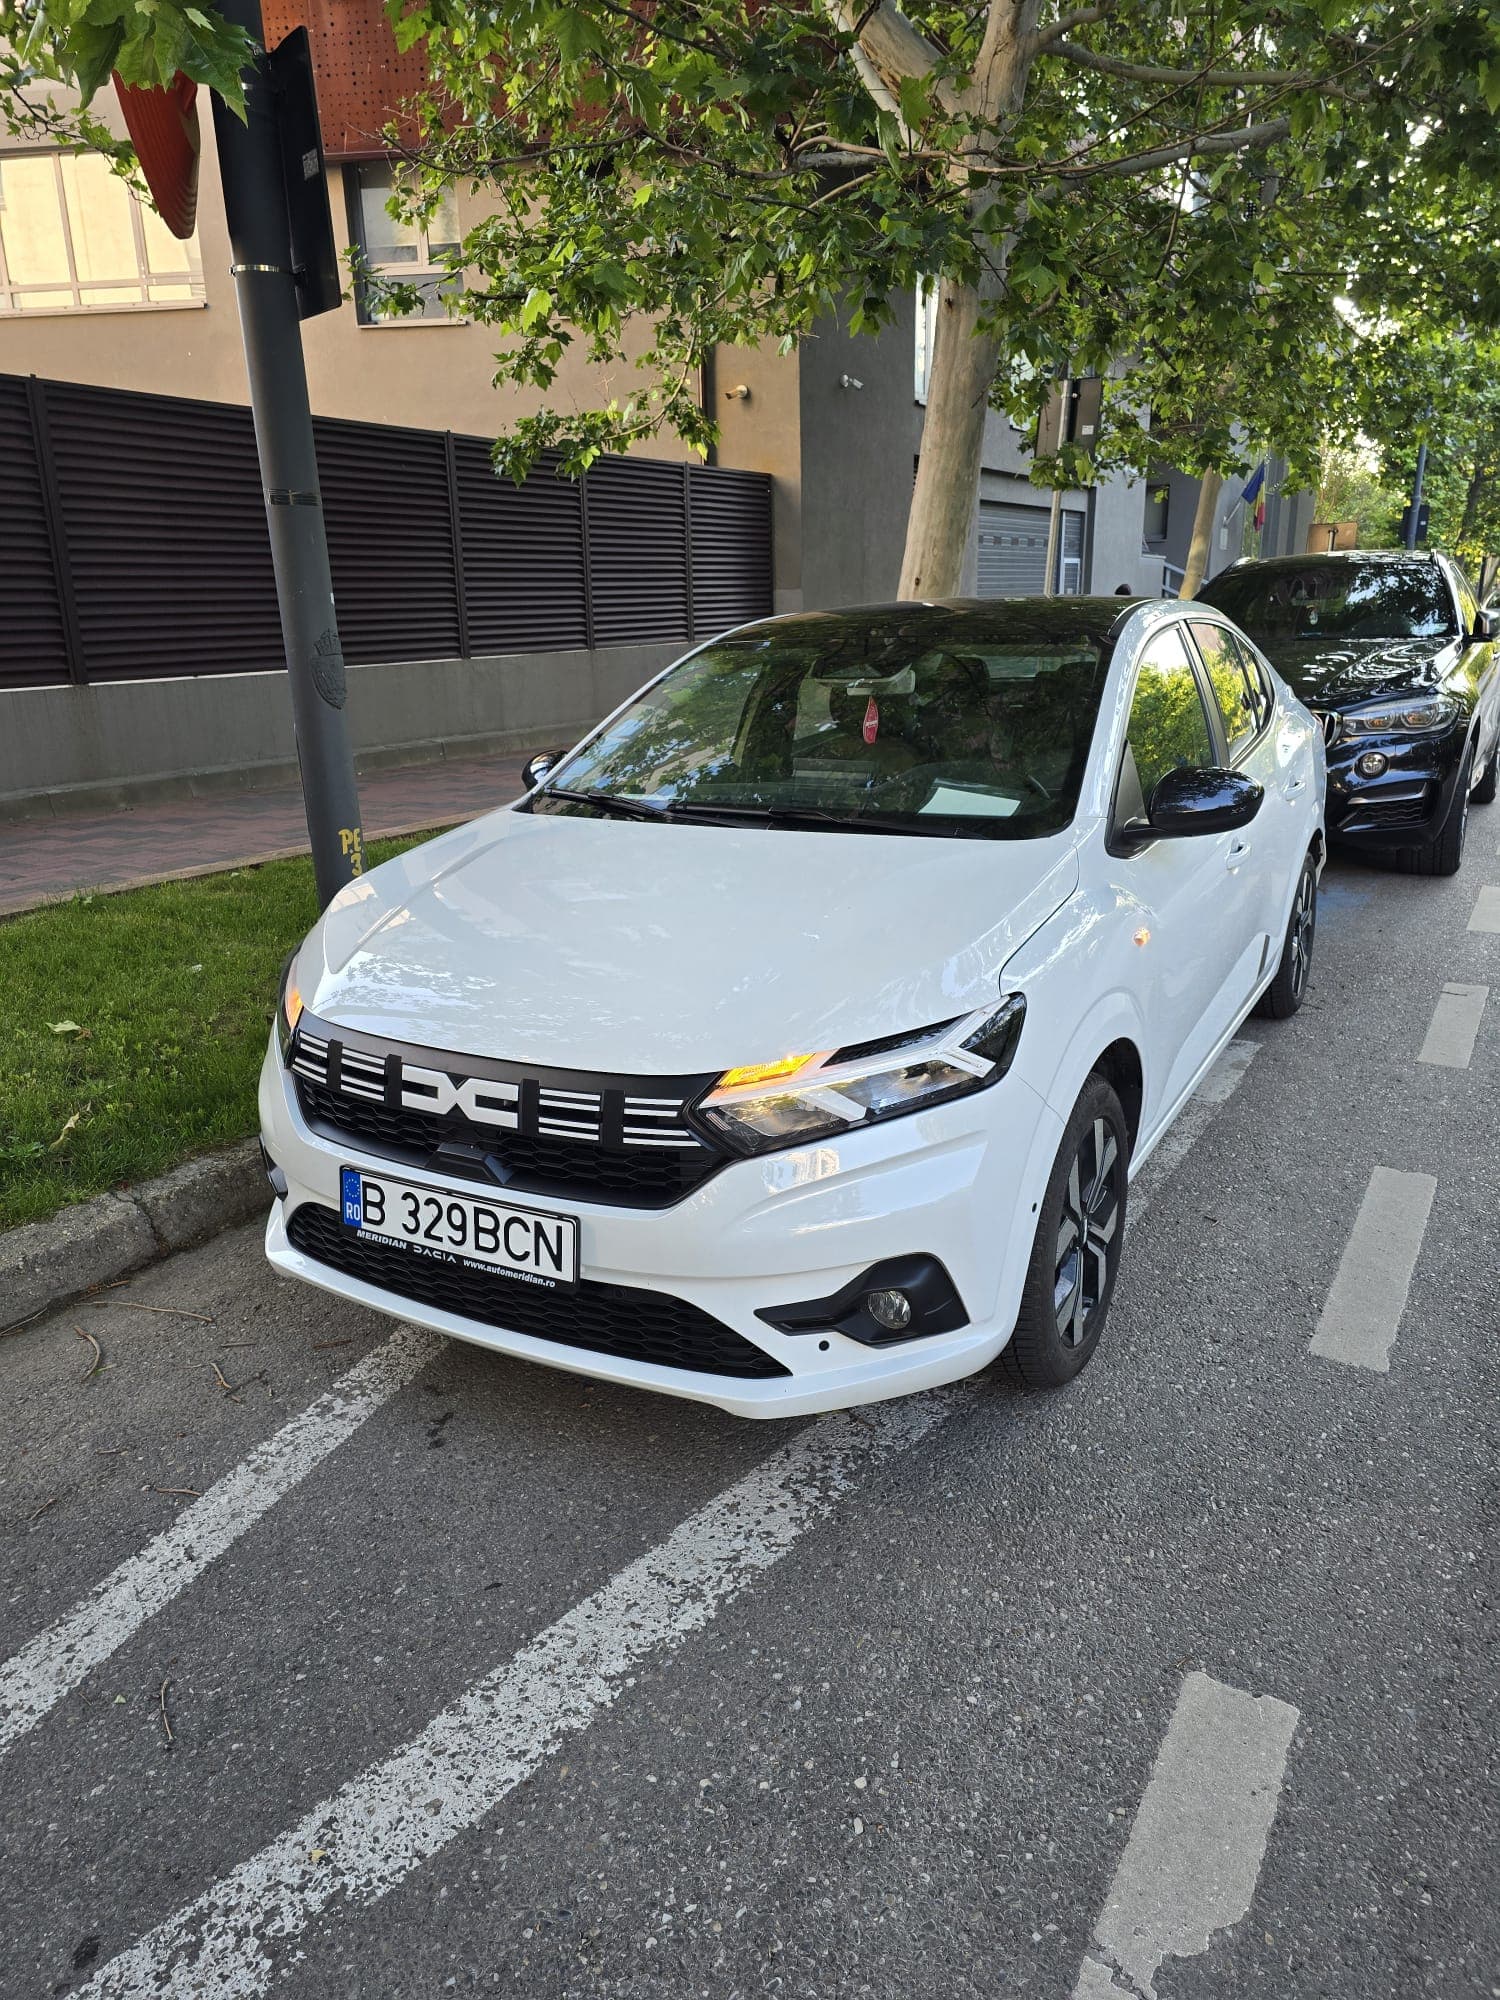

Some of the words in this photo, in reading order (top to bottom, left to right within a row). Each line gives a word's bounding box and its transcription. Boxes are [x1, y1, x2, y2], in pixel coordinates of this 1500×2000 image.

[351, 853, 363, 876] 3
[345, 1202, 361, 1221] RO
[362, 1180, 386, 1226] B
[356, 1229, 407, 1250] MERIDIAN
[413, 1245, 457, 1264] DACIA
[463, 1259, 556, 1288] www.automeridian.ro
